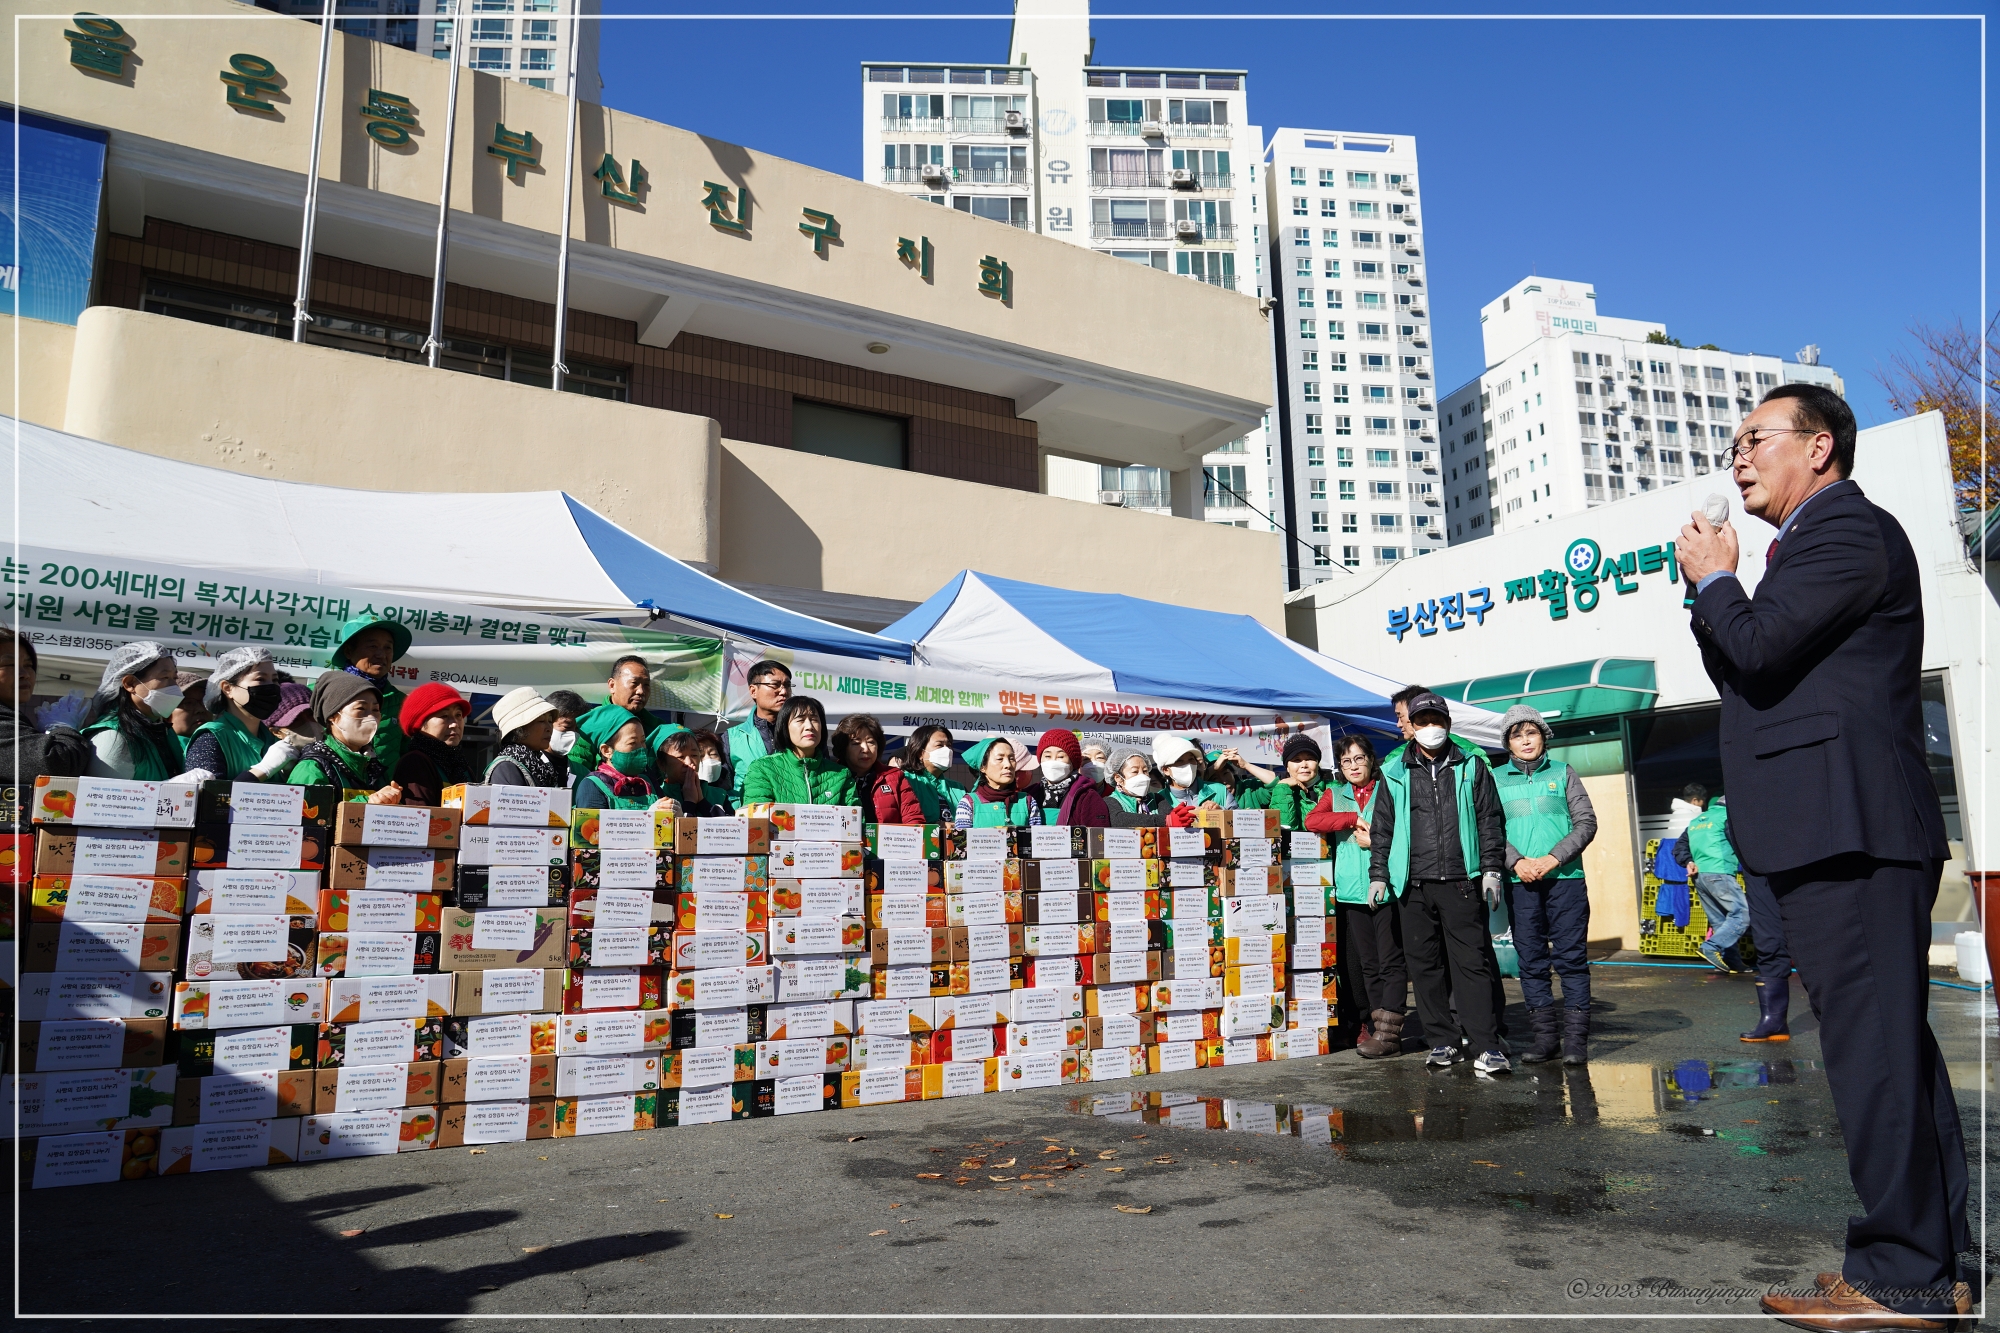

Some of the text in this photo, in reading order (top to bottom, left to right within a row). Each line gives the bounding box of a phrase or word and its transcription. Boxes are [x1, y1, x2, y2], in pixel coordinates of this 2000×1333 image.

[1046, 159, 1073, 232] 유원
[39, 562, 186, 603] 200세대의
[194, 580, 350, 623] 복지사각지대
[480, 618, 542, 645] 결연을
[548, 626, 588, 648] 맺고
[1386, 538, 1679, 643] 부산진구 재활용센터
[4, 591, 64, 622] 지원
[73, 600, 160, 632] 사업을
[168, 610, 275, 642] 전개하고
[430, 670, 499, 686] 중앙OA시스템
[902, 715, 920, 727] 일시
[914, 685, 955, 706] 세계와
[998, 690, 1038, 718] 행복
[1042, 695, 1062, 720] 두
[1065, 698, 1085, 722] 배
[1086, 701, 1140, 726] 사랑의
[1140, 706, 1207, 732] 김장김치
[1207, 714, 1252, 738] 나누기
[349, 818, 363, 829] 맛
[322, 1083, 337, 1095] 맛
